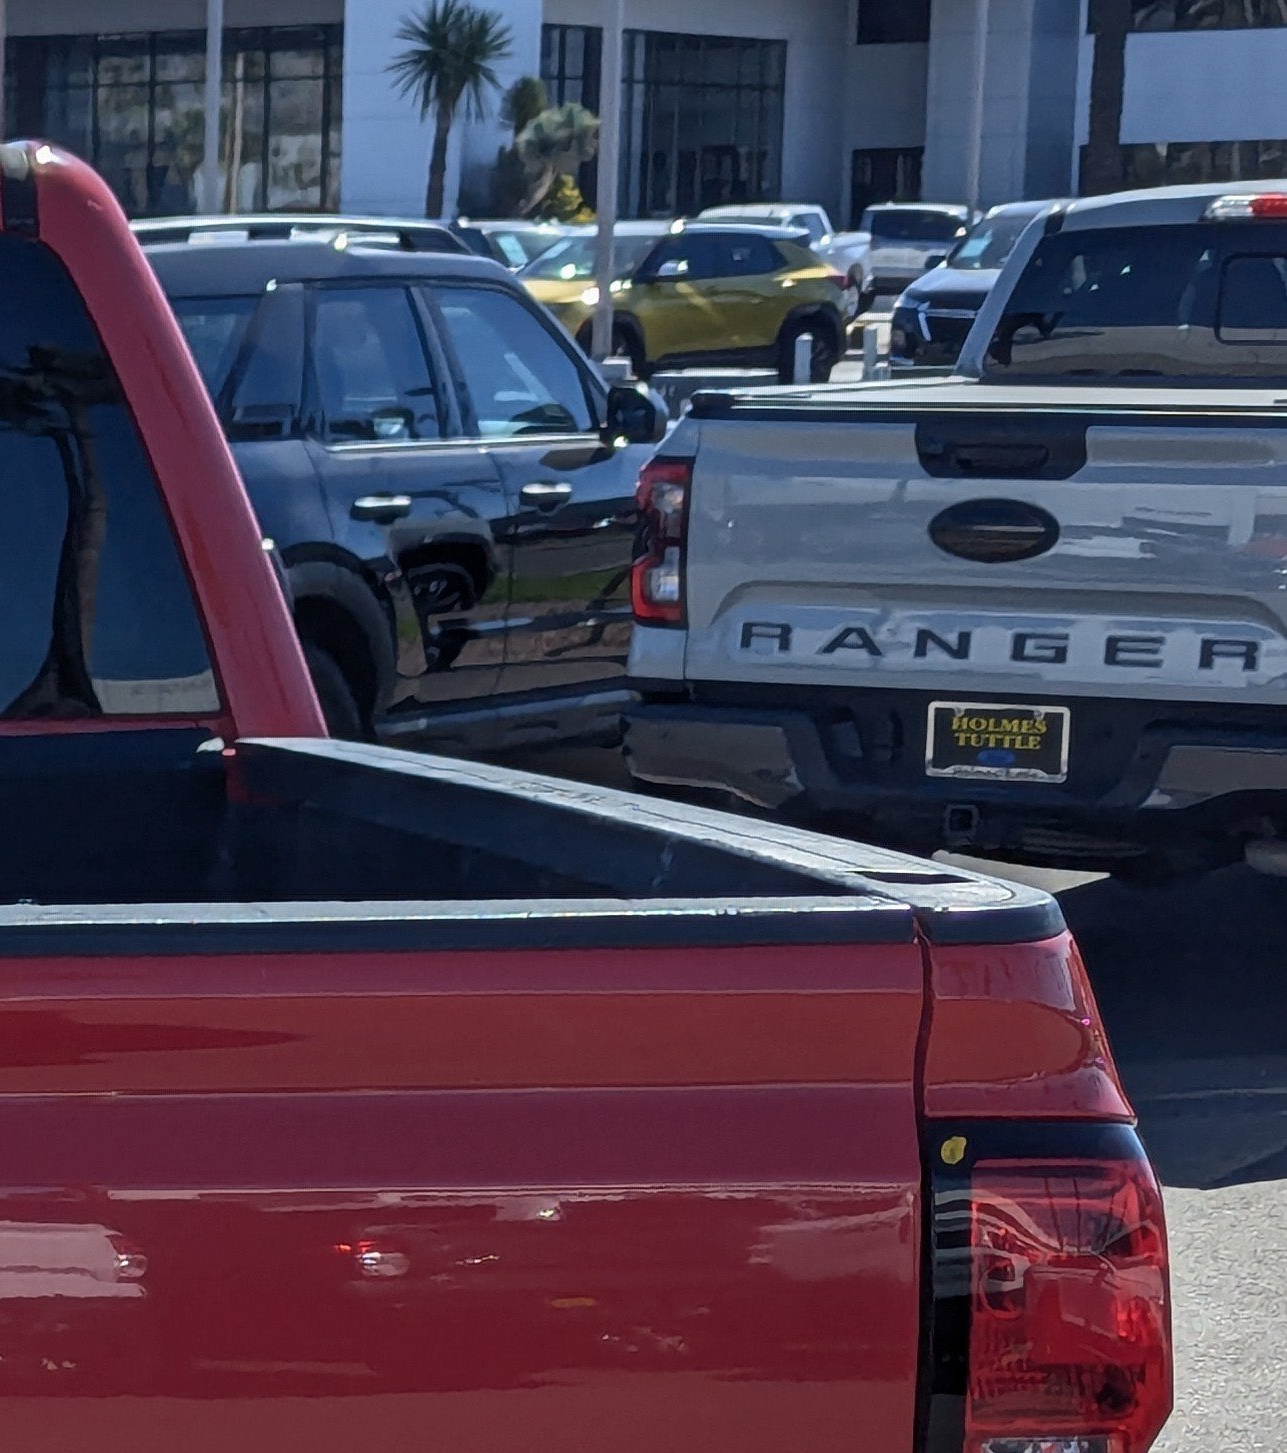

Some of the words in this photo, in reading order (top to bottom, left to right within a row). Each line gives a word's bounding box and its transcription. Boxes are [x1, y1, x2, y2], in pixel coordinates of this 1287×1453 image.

[739, 621, 1259, 672] RANGER
[951, 715, 1048, 735] HOLMES
[954, 732, 1041, 750] TUTTLE
